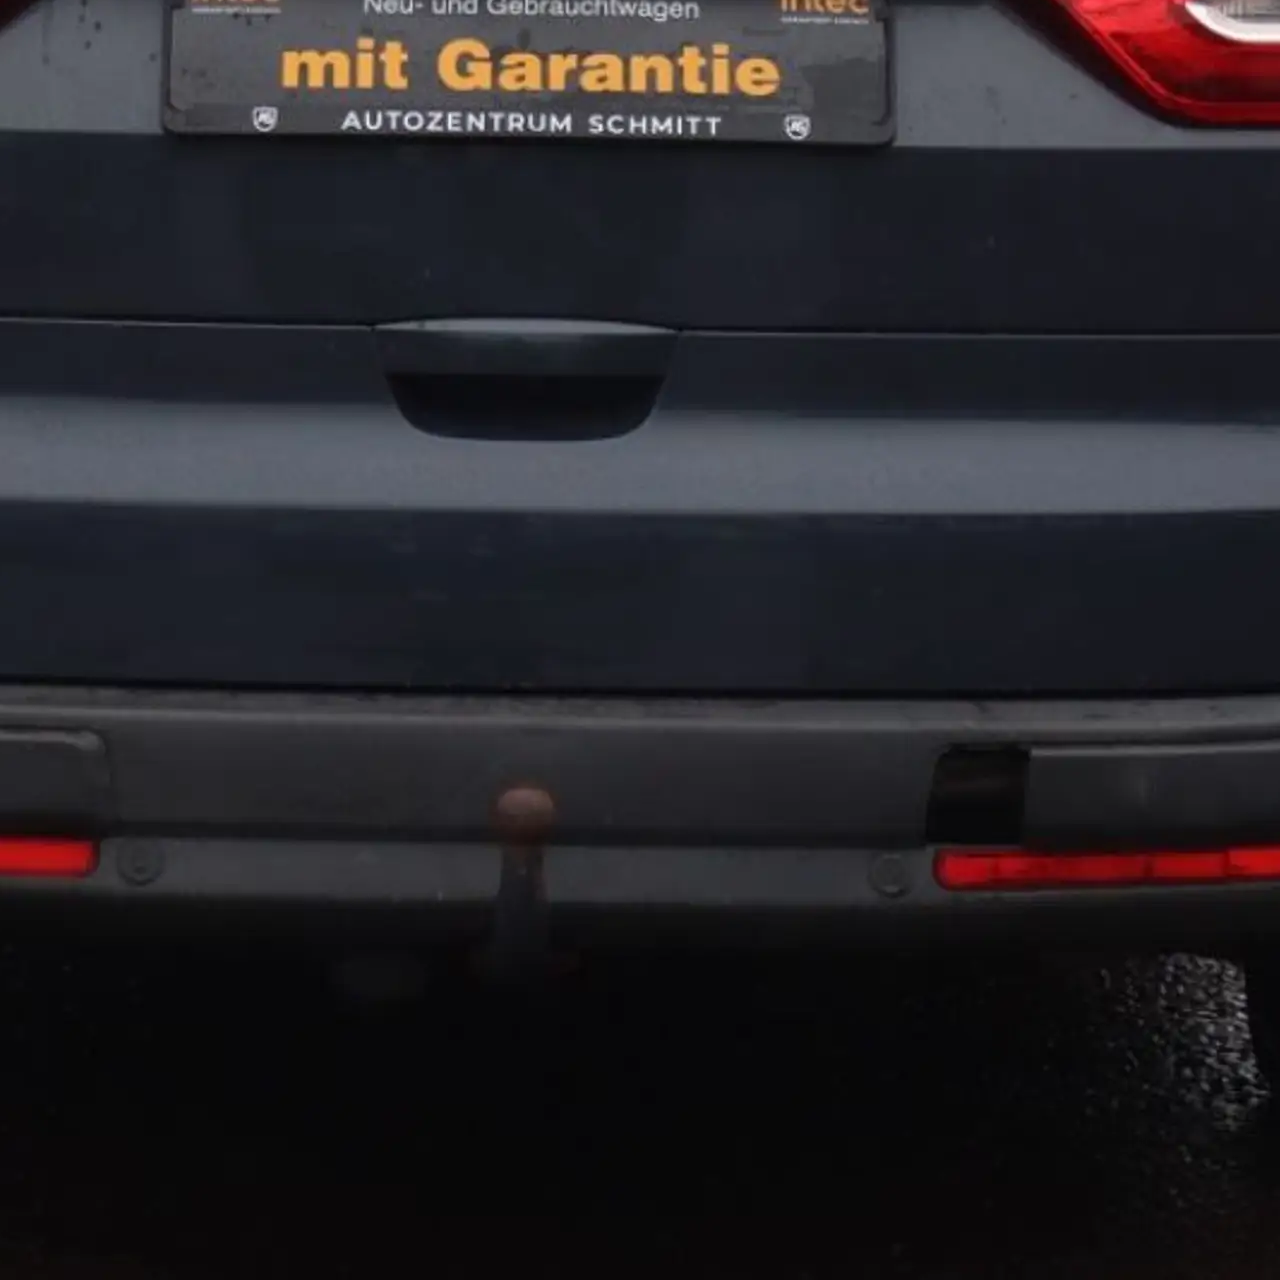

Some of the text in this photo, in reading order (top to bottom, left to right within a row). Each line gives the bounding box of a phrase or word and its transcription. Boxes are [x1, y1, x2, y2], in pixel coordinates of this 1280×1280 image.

[281, 36, 782, 97] mit Garantie
[339, 109, 723, 137] AUTOZENTRUM SCHMITT
